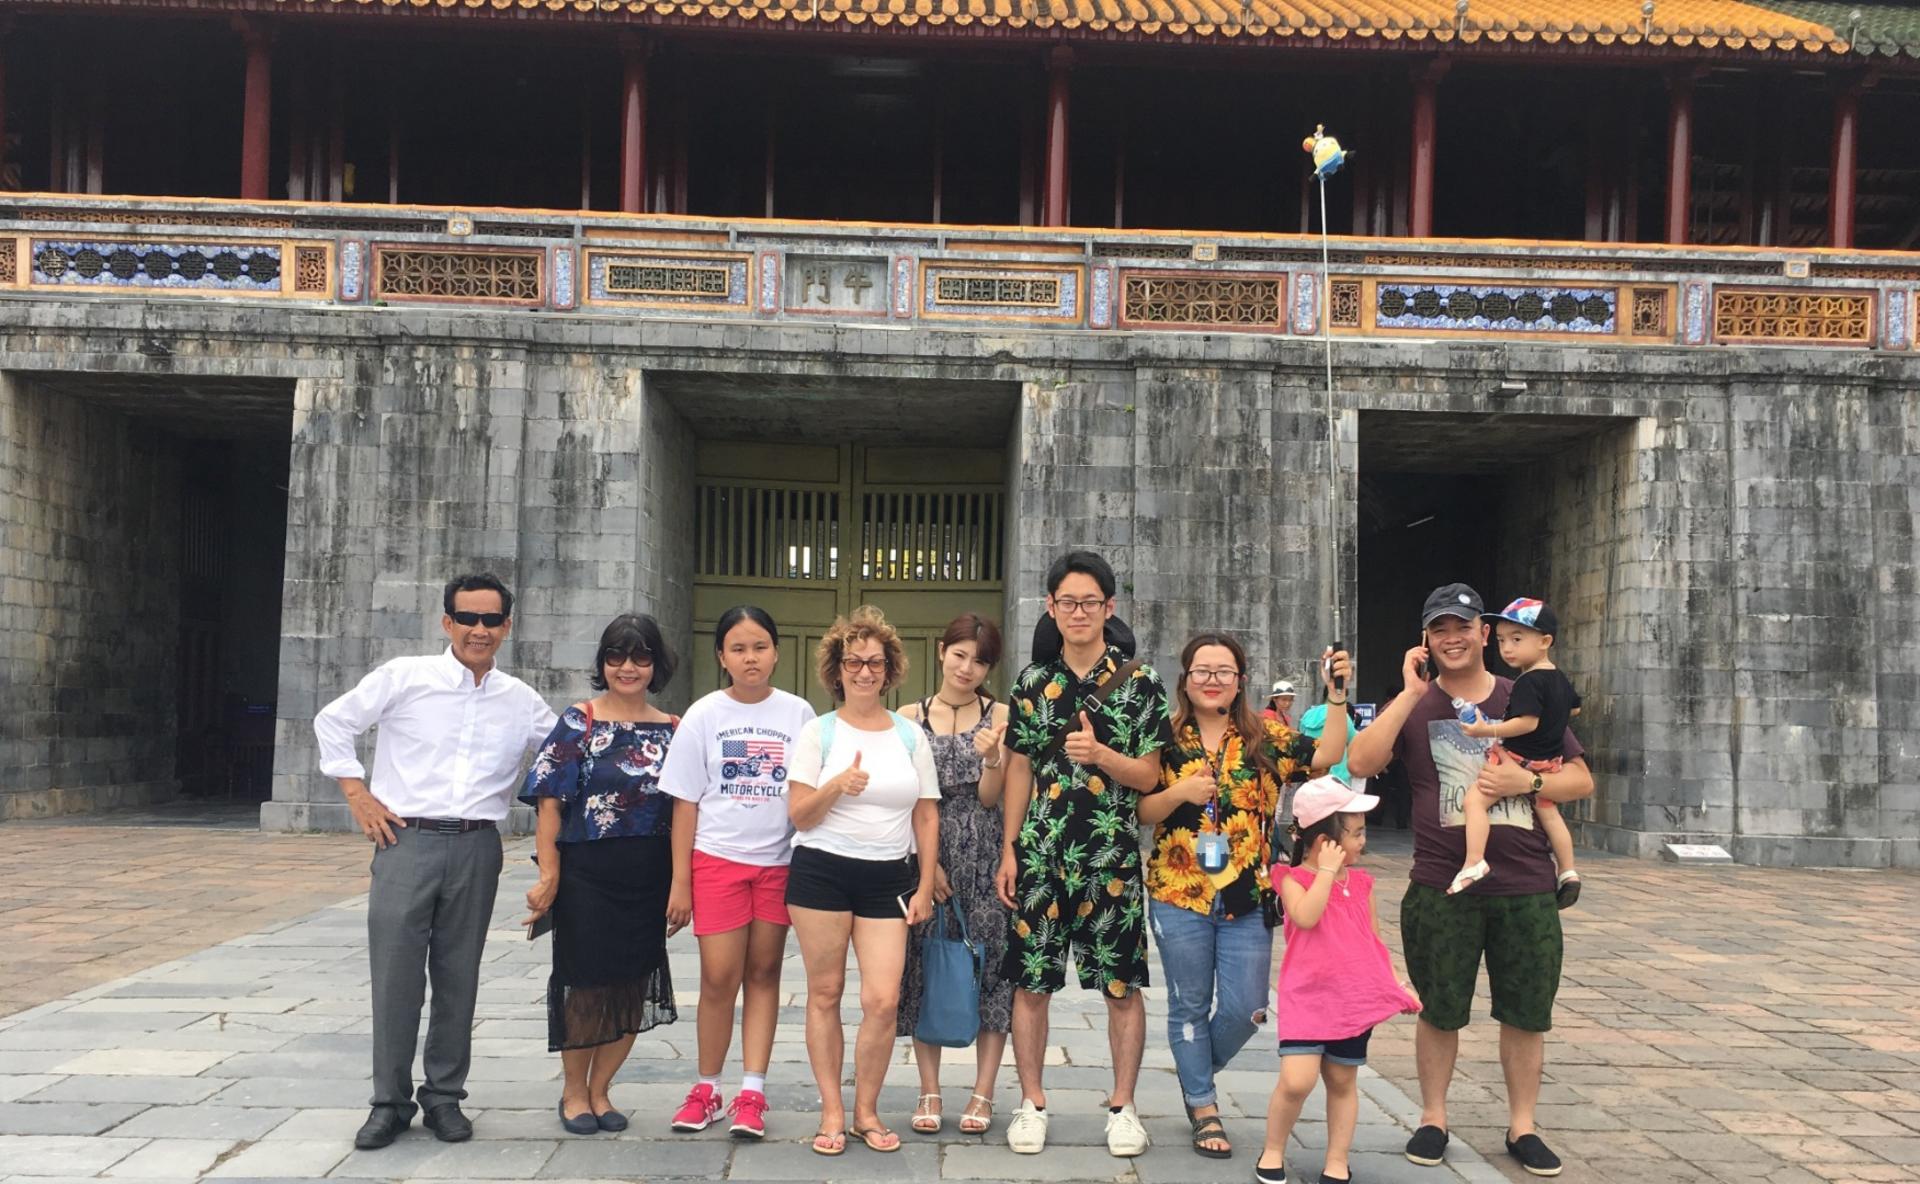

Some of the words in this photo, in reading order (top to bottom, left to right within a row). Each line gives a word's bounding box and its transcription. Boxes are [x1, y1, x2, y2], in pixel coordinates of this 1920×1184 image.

[716, 727, 754, 741] AMERICAN
[756, 727, 792, 743] CHOPPER
[720, 783, 784, 798] MOTORCYCLE
